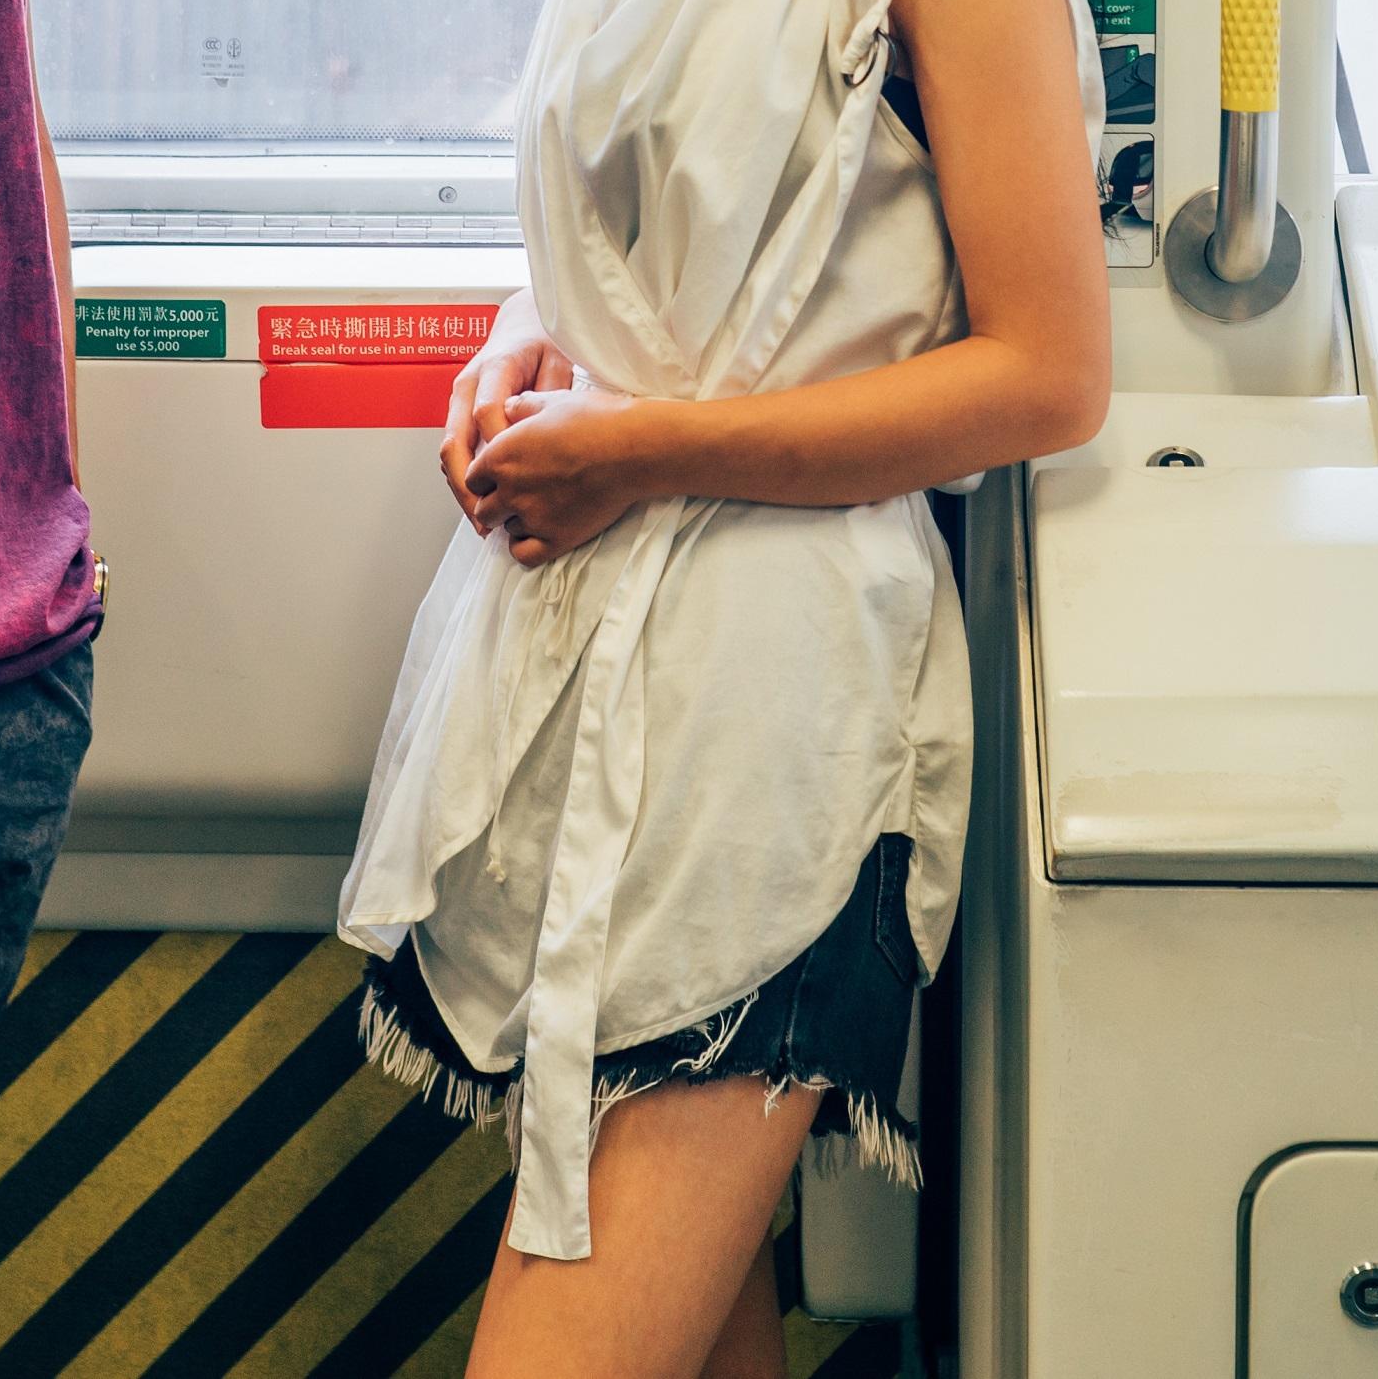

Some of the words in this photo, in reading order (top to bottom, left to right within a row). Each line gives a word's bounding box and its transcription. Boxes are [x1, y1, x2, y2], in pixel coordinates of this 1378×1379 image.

[1111, 15, 1131, 25] exit
[85, 326, 130, 340] Penalty
[133, 326, 150, 338] for
[153, 327, 210, 340] improper
[270, 316, 488, 339] 緊急時撕開封條使用
[116, 341, 137, 352] use
[140, 340, 180, 353] $5,000
[272, 344, 308, 356] Break
[311, 344, 335, 356] seal
[339, 343, 356, 355] for
[360, 345, 381, 355] use
[384, 342, 396, 355] in
[399, 345, 414, 355] an
[418, 345, 481, 357] emergenc
